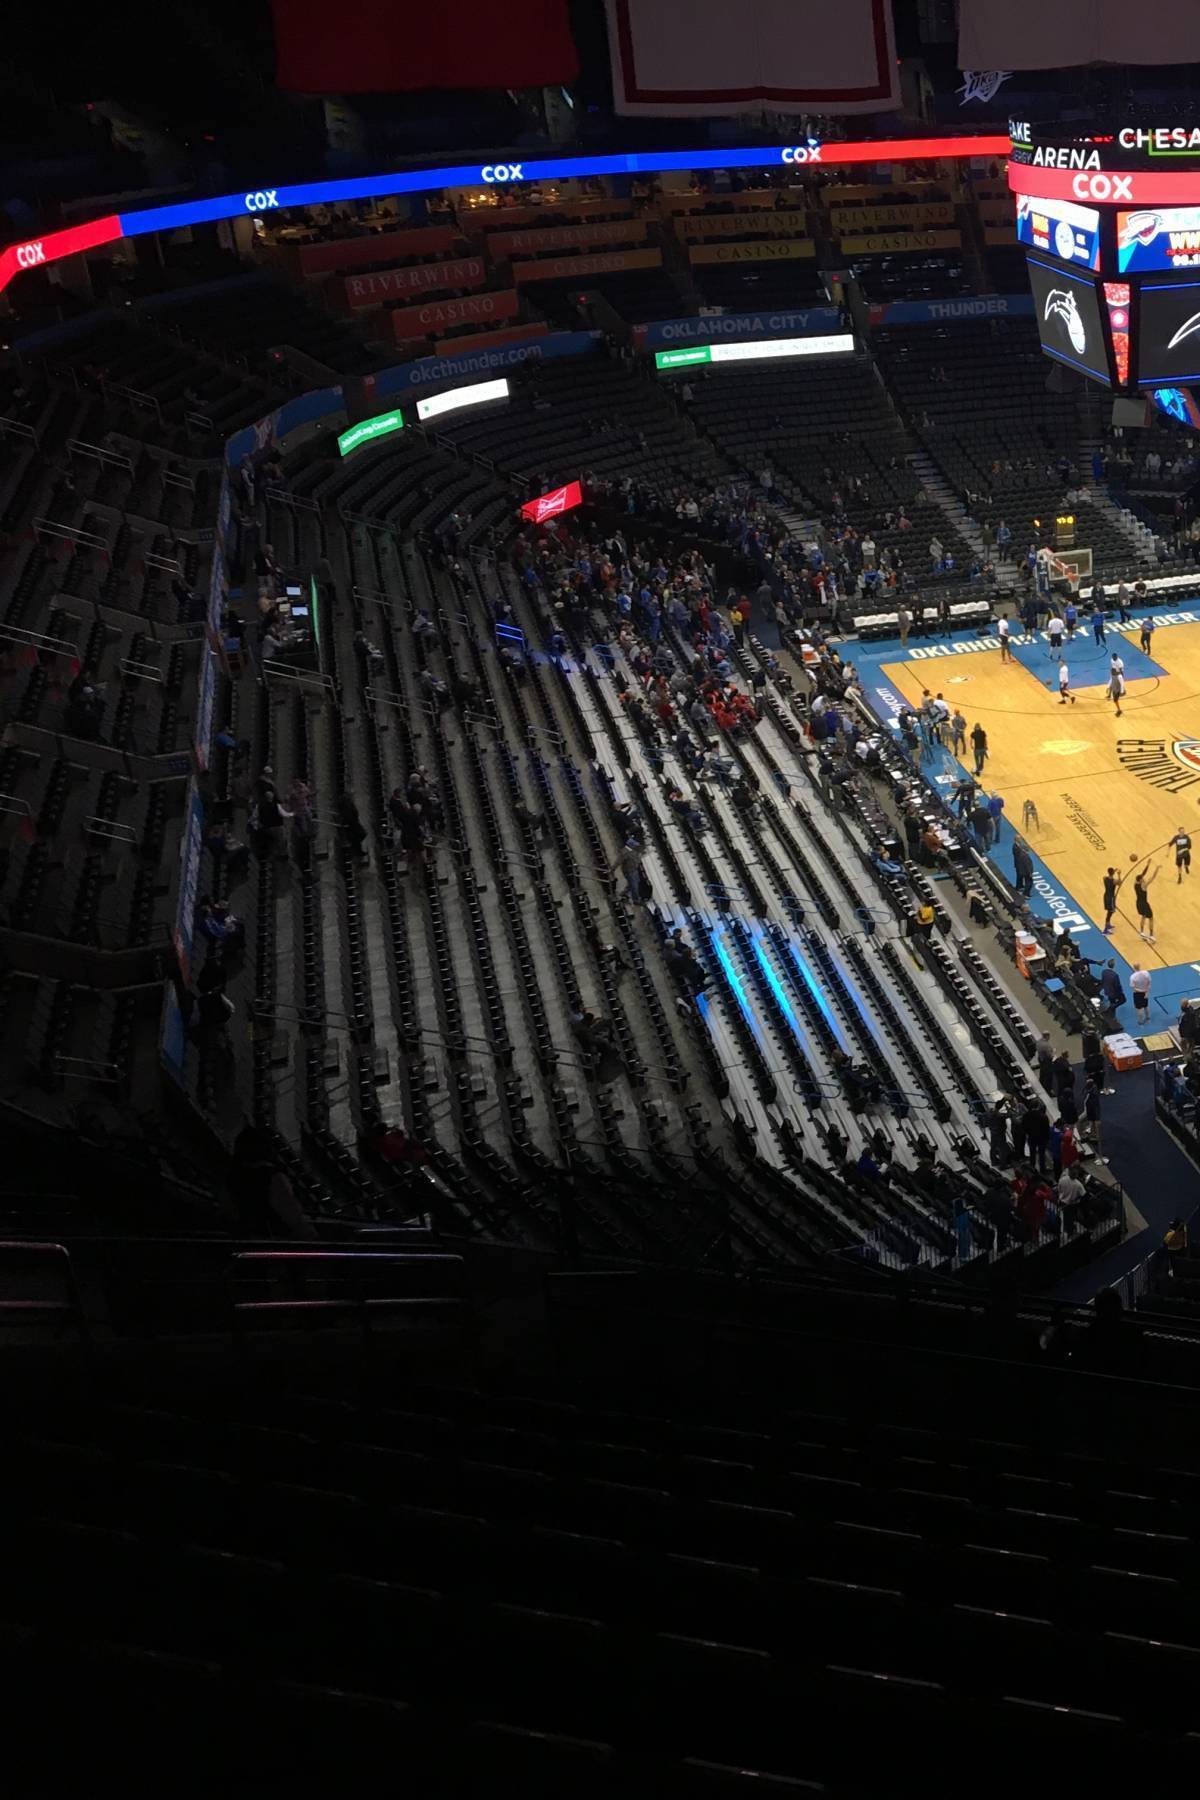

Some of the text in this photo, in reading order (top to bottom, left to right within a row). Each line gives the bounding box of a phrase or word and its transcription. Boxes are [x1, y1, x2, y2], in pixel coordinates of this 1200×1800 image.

[781, 146, 822, 164] COX
[1032, 146, 1101, 170] ARENA
[481, 163, 524, 184] COX
[1072, 173, 1133, 200] COX
[245, 190, 279, 212] COX
[683, 214, 800, 233] RIVERWIND
[838, 206, 950, 224] RIVERWIND
[512, 225, 627, 248] RIVERWIND
[866, 234, 937, 250] CASINO
[17, 242, 46, 268] COX
[716, 244, 791, 260] CASINO
[554, 256, 626, 275] CASINO
[352, 262, 480, 295] RIVERWIND
[419, 299, 495, 324] CASINO
[927, 299, 1009, 319] THUNDER
[662, 314, 809, 339] OKLAHOMA CITY
[409, 343, 542, 385] okcthunder.com
[1066, 813, 1107, 852] CHESAPEAKE
